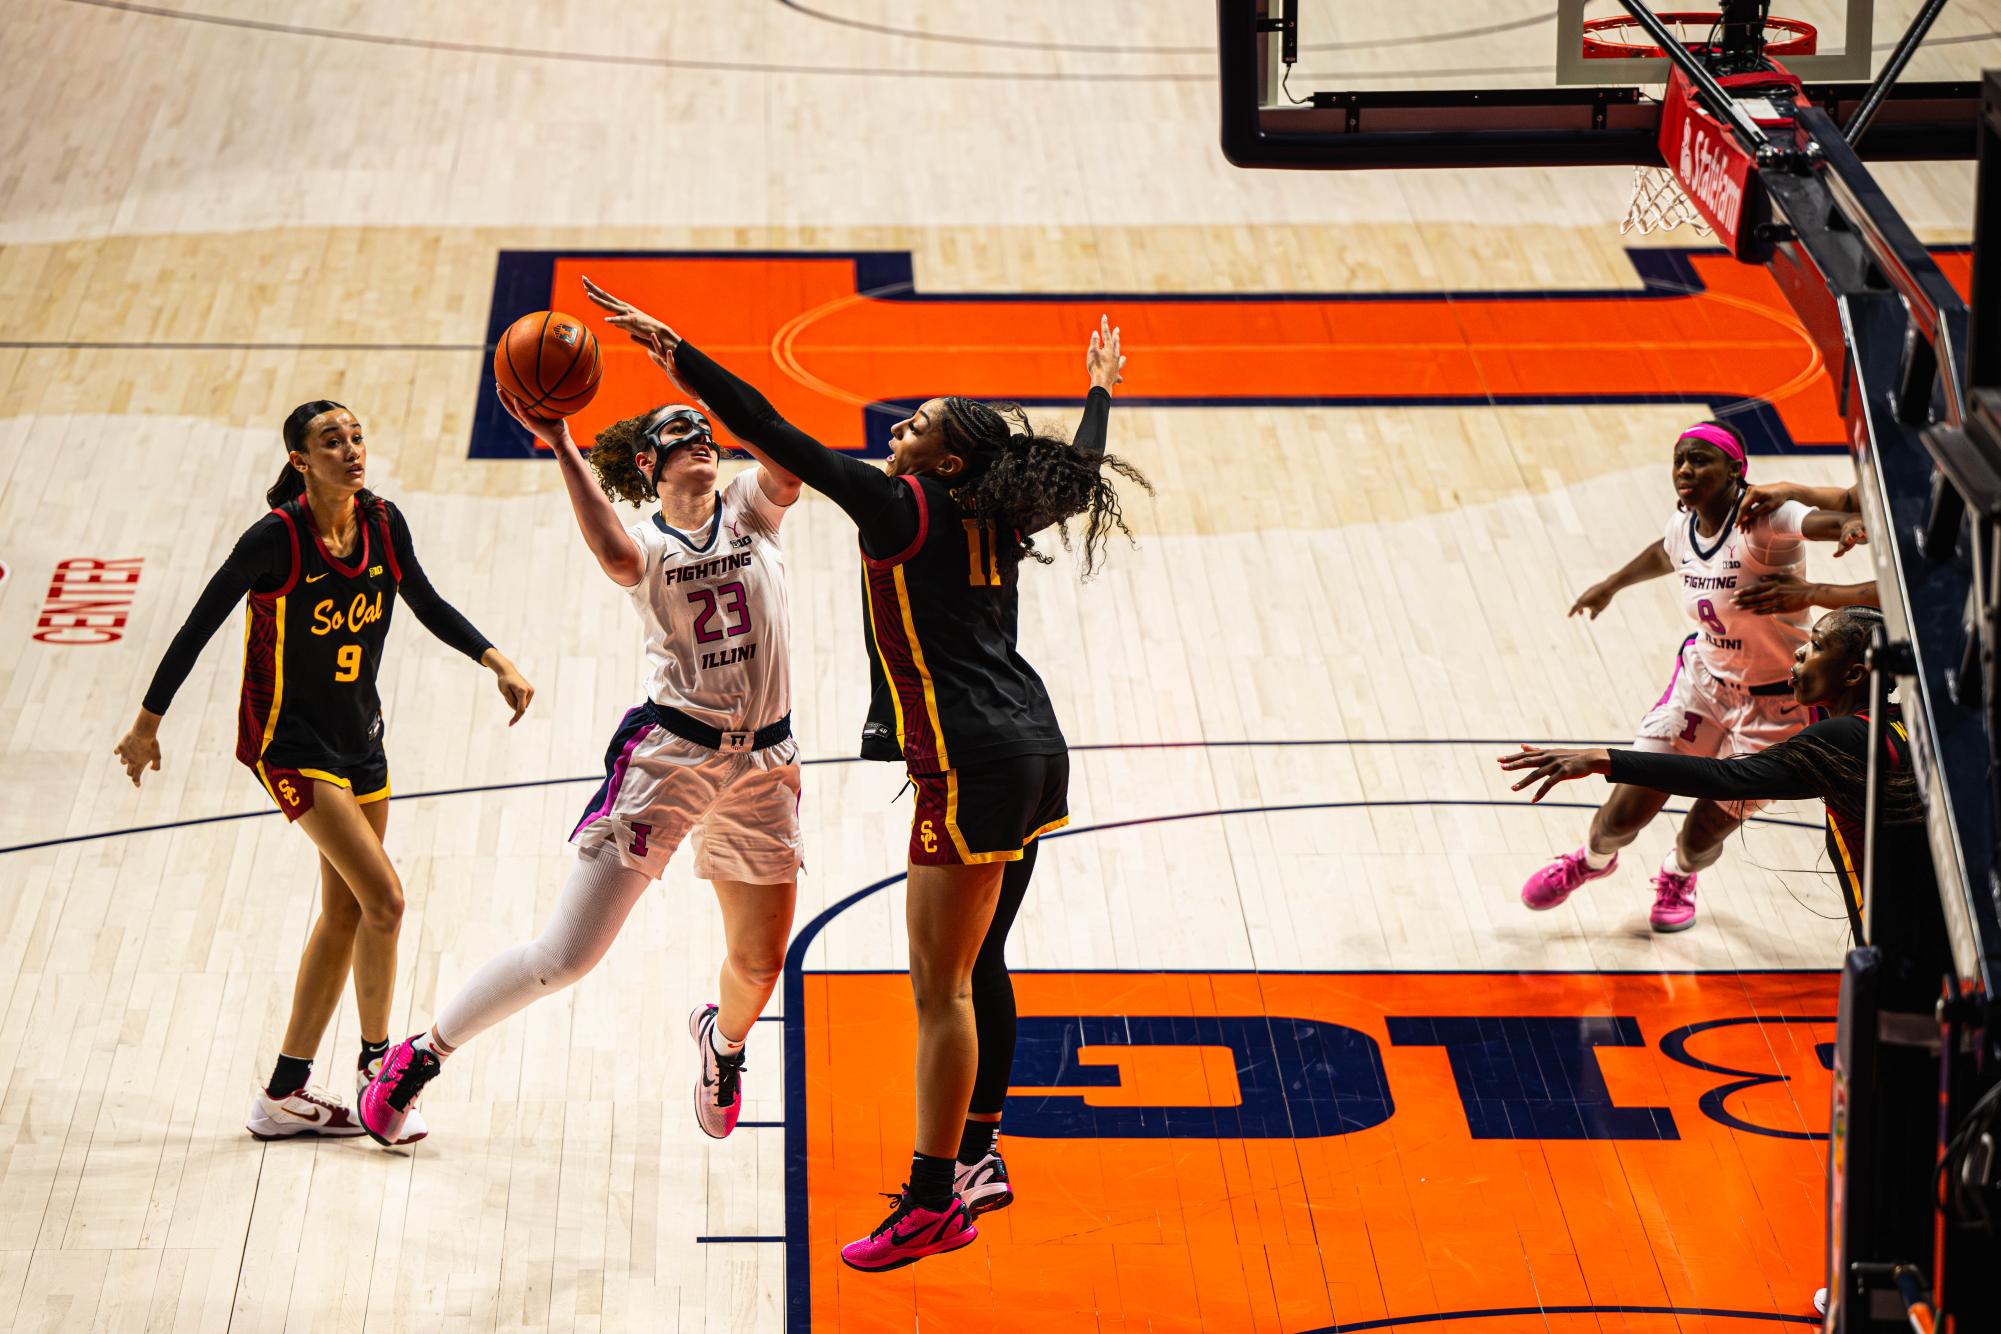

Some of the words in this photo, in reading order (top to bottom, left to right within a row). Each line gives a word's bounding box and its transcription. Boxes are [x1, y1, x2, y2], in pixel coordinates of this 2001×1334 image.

[665, 552, 751, 586] FIGHTING
[1684, 575, 1737, 589] FIGHTING
[32, 557, 144, 645] CENTER
[310, 598, 345, 636] So
[347, 591, 383, 633] Cal
[687, 581, 752, 644] 23
[702, 643, 757, 669] ILLINI
[1705, 632, 1742, 650] ILLINI
[335, 644, 362, 682] 9
